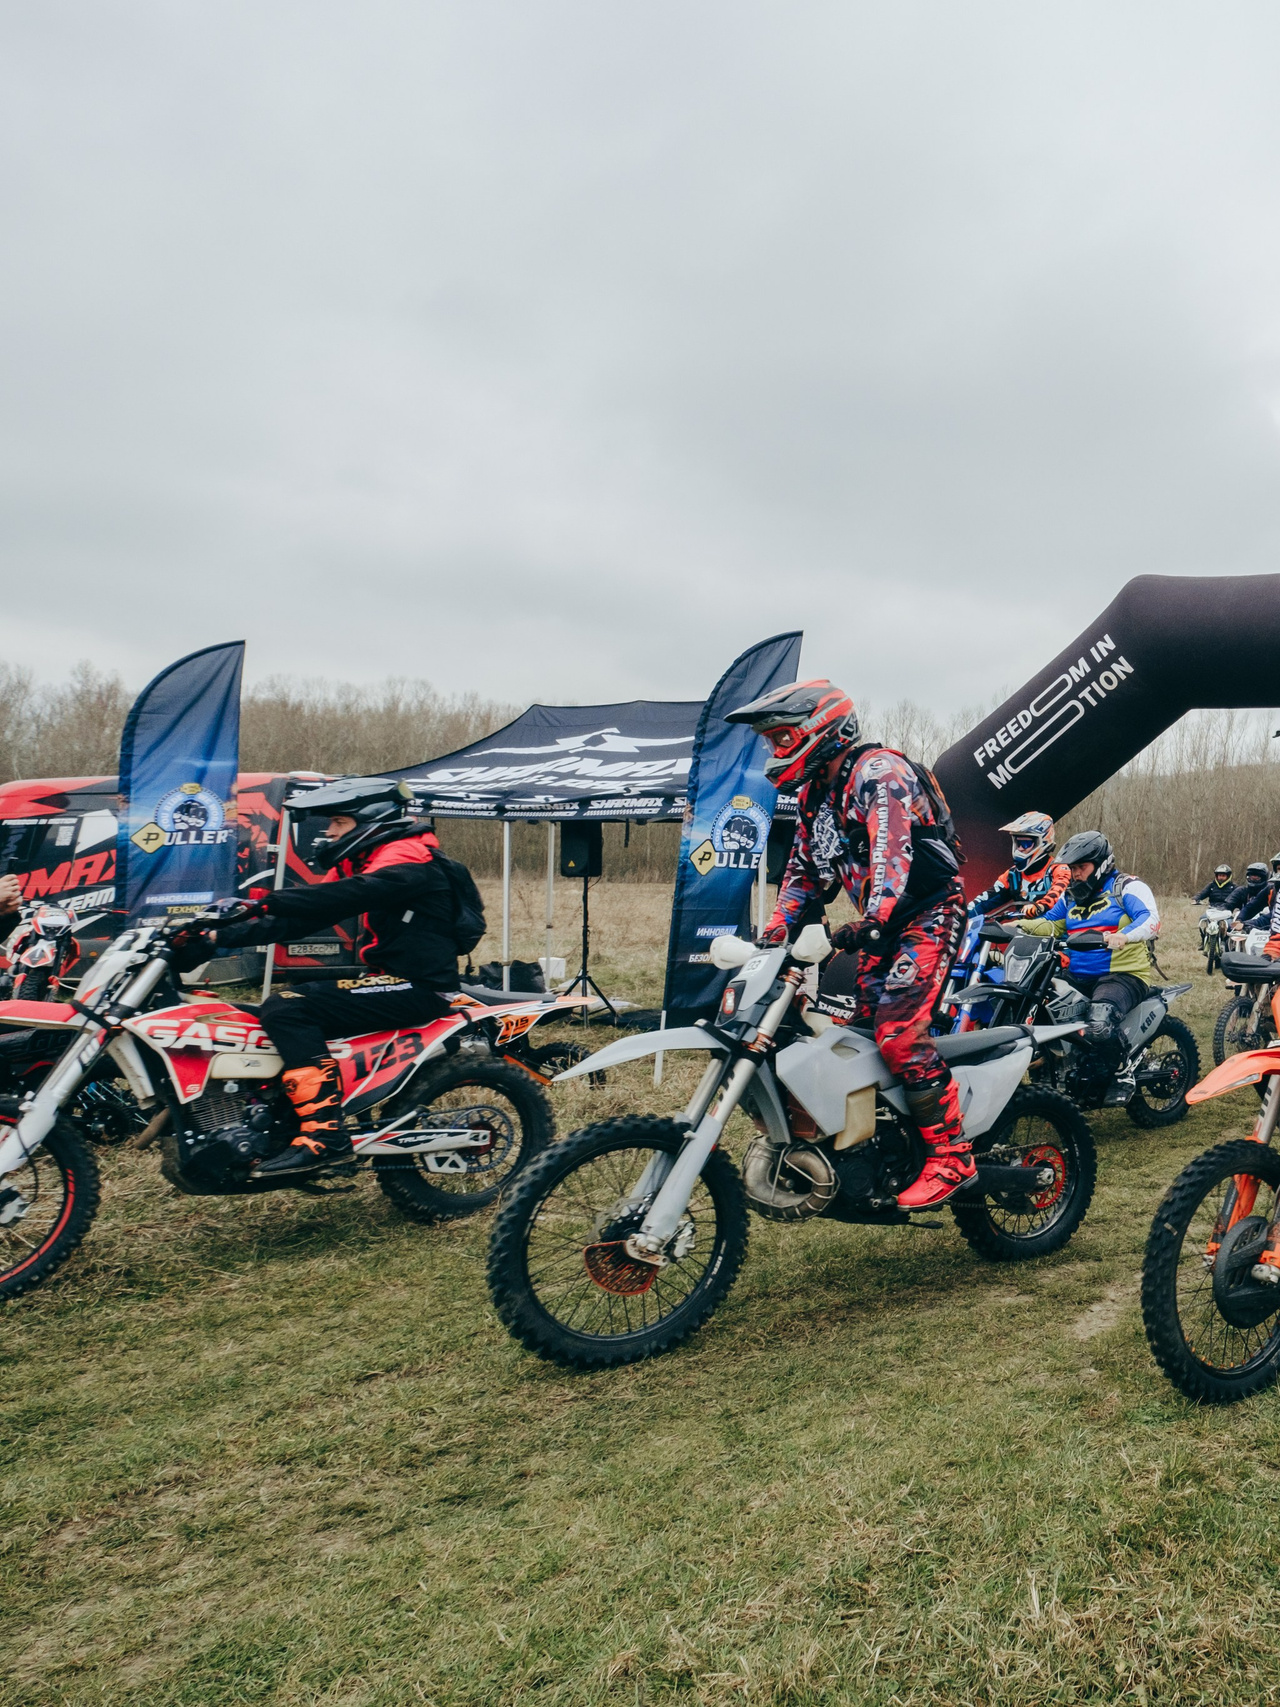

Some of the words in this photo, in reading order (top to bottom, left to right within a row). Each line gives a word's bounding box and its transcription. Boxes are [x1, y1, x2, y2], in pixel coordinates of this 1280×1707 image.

[973, 657, 1092, 768] FREEDOM
[1090, 633, 1117, 664] IN
[987, 655, 1135, 790] MOTION
[588, 797, 665, 809] SHARMAX
[142, 829, 228, 846] PULLER
[58, 886, 116, 911] TEAM
[349, 1032, 425, 1082] 123
